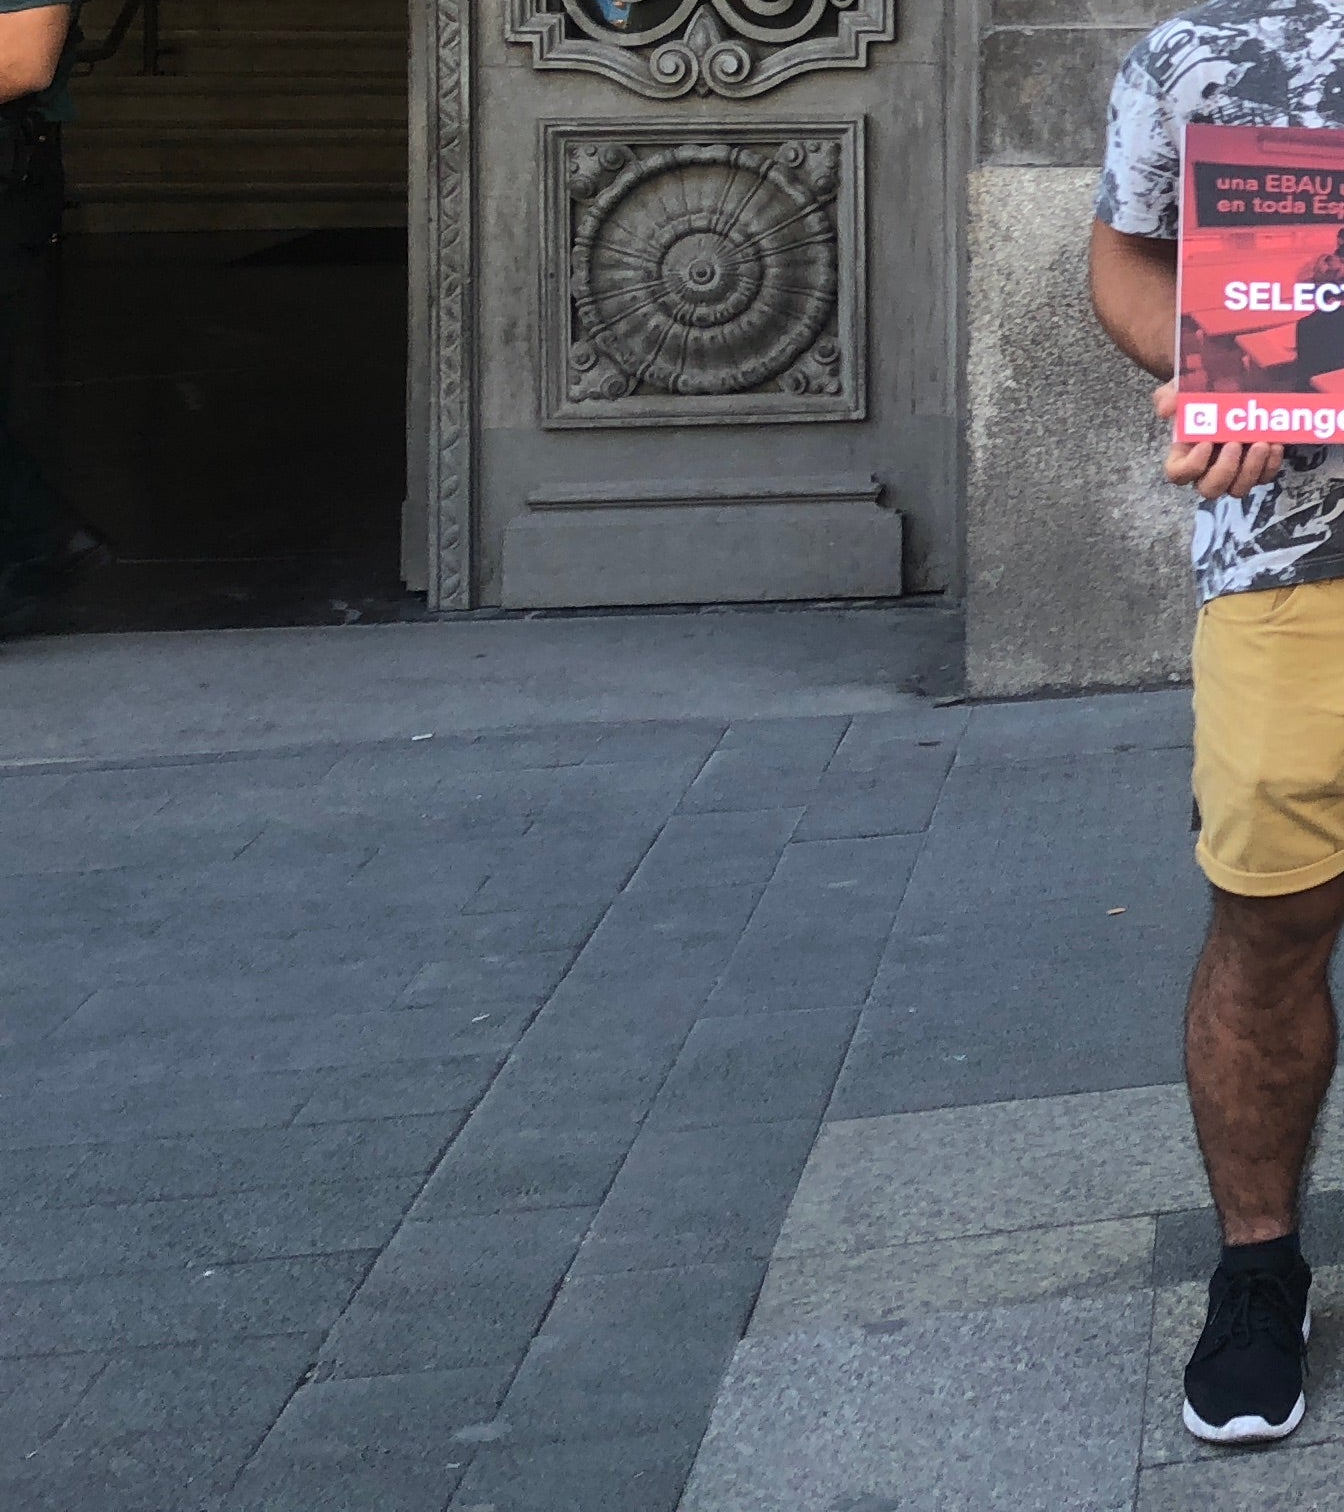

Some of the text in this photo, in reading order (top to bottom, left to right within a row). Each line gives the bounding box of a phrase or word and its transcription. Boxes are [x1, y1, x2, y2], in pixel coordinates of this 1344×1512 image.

[1216, 177, 1259, 191] una
[1264, 174, 1333, 195] EBAU
[1216, 199, 1246, 213] en
[1253, 196, 1306, 214] toda
